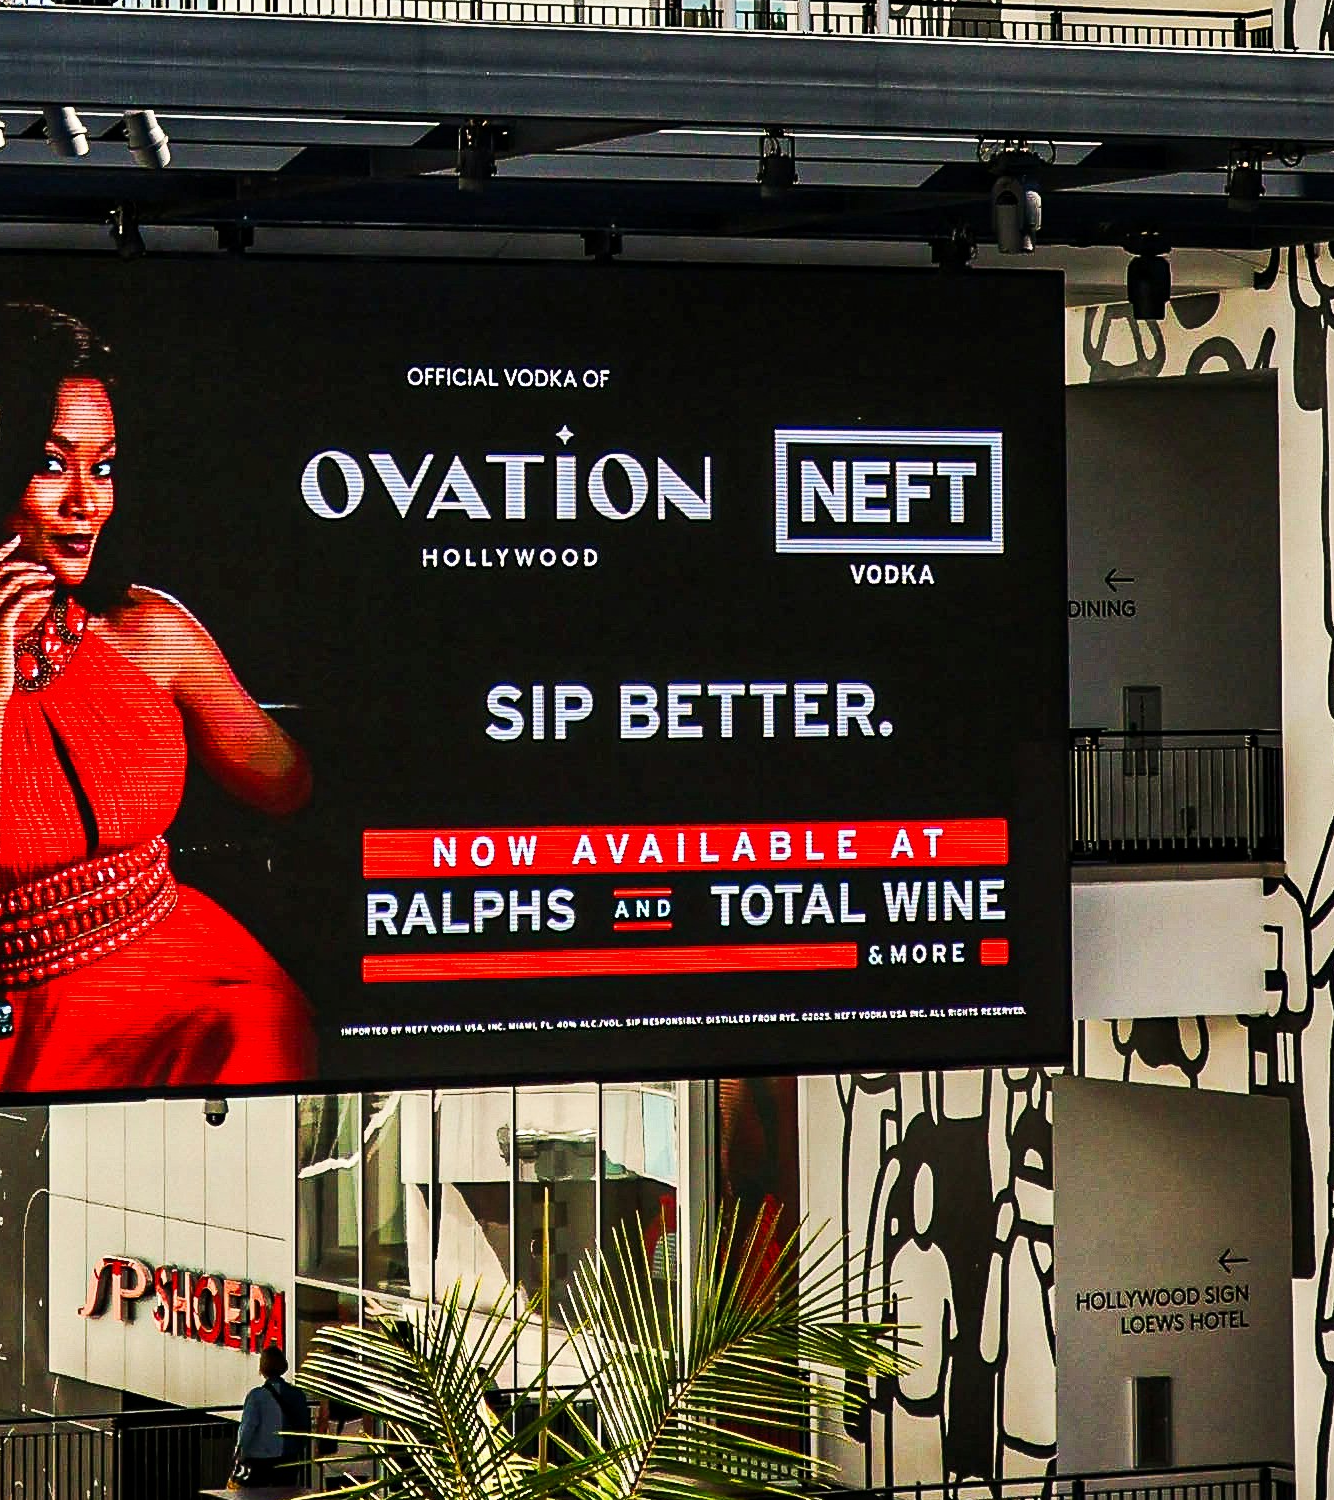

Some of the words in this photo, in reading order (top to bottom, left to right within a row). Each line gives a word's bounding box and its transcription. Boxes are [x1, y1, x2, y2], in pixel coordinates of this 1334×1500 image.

[407, 368, 498, 386] OFFICIAL
[504, 369, 577, 387] VODKA
[583, 370, 610, 387] OF
[301, 425, 711, 521] OVATION
[801, 460, 977, 523] NEFT
[423, 549, 597, 567] HOLLYWOOD
[851, 565, 934, 584] VODKA
[1068, 600, 1136, 618] DINING
[485, 684, 593, 741] SIP
[620, 683, 893, 740] BETTER.
[433, 836, 536, 867] NOW
[572, 829, 857, 864] AVAILABLE
[890, 829, 943, 858] AT
[367, 890, 575, 935] RALPHS
[615, 899, 671, 917] AND
[711, 883, 866, 926] TOTAL
[883, 880, 1006, 922] WINE
[1077, 1288, 1199, 1310] HOLLYWOOD
[1205, 1285, 1249, 1304] SIGN
[1122, 1314, 1184, 1334] LOEWS
[1191, 1310, 1249, 1330] HOTEL
